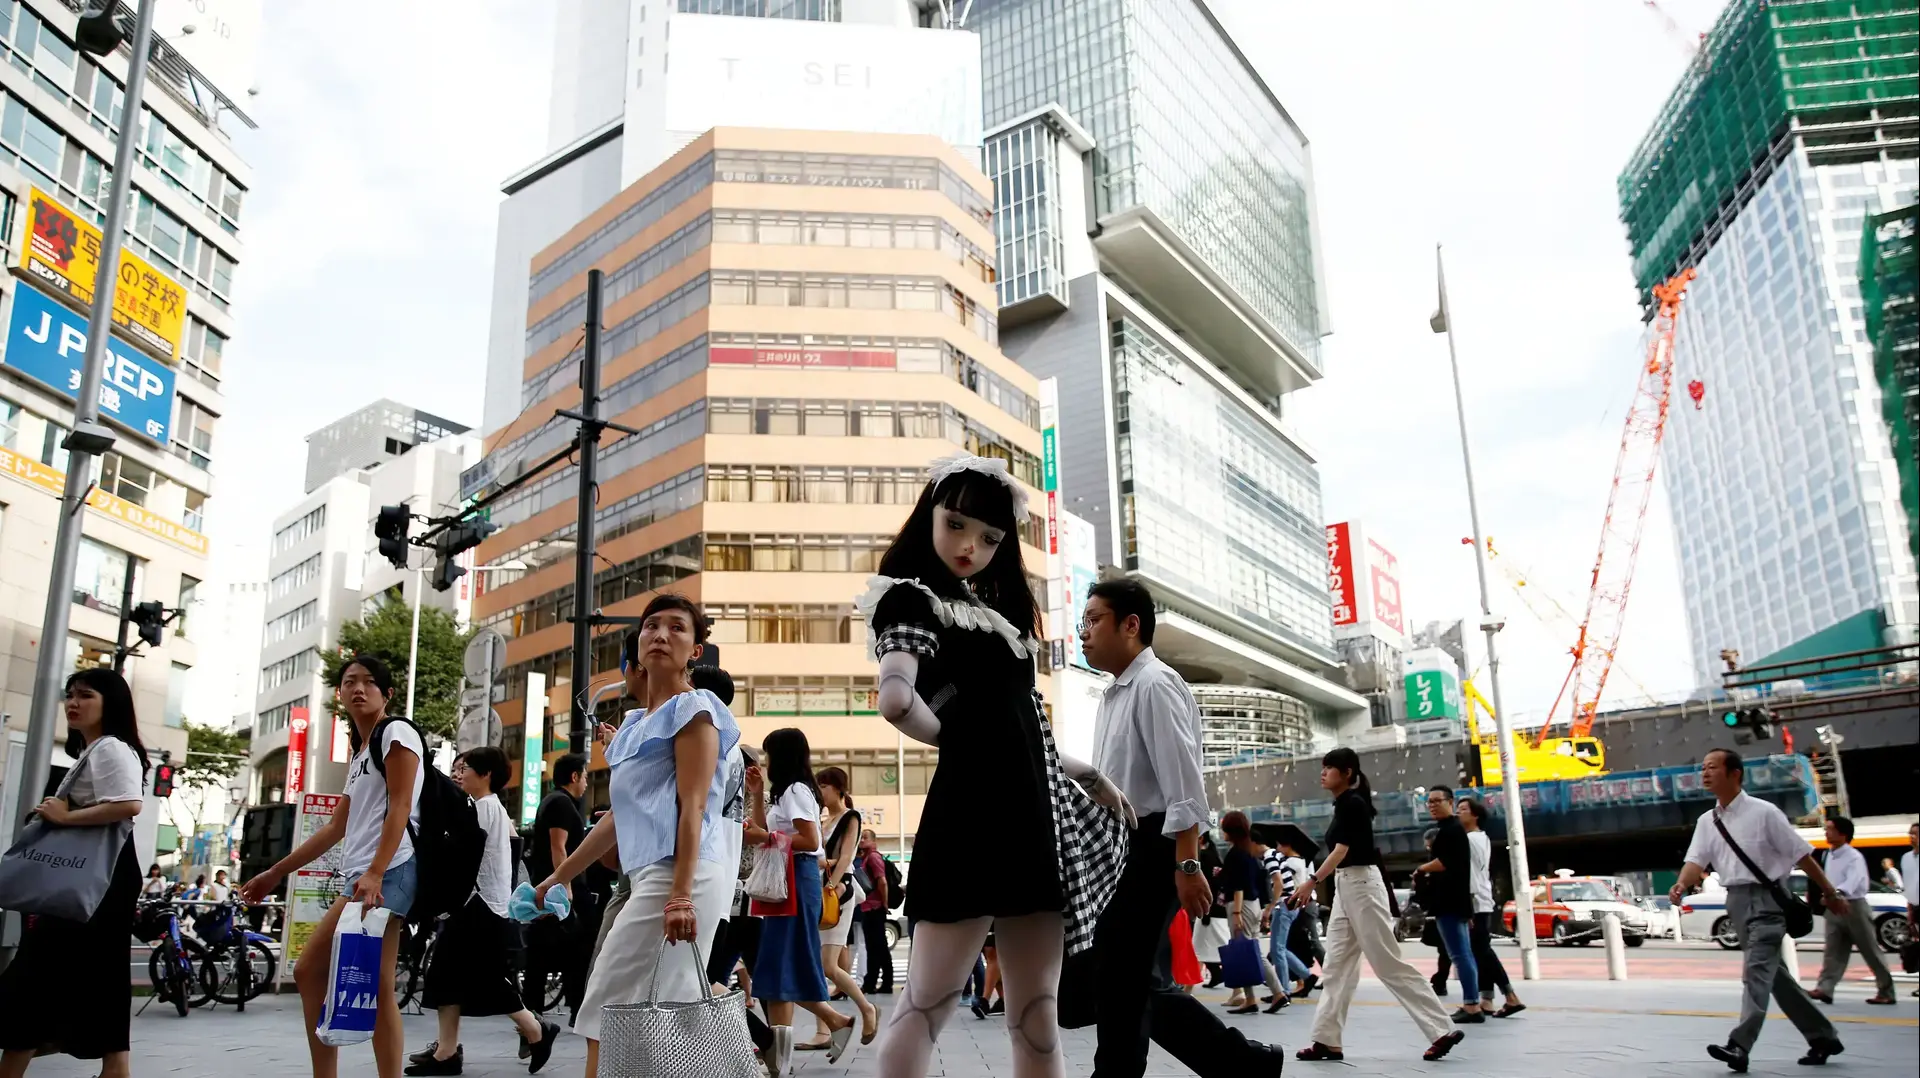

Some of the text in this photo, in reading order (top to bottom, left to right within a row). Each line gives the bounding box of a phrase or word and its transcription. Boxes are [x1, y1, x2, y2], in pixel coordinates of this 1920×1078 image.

[82, 229, 180, 320] 写の学校
[757, 352, 822, 365] 三井のリハウス
[68, 368, 122, 413] 英塾
[146, 418, 165, 438] 6F
[1416, 674, 1433, 716] レイク
[18, 848, 87, 869] Marigold
